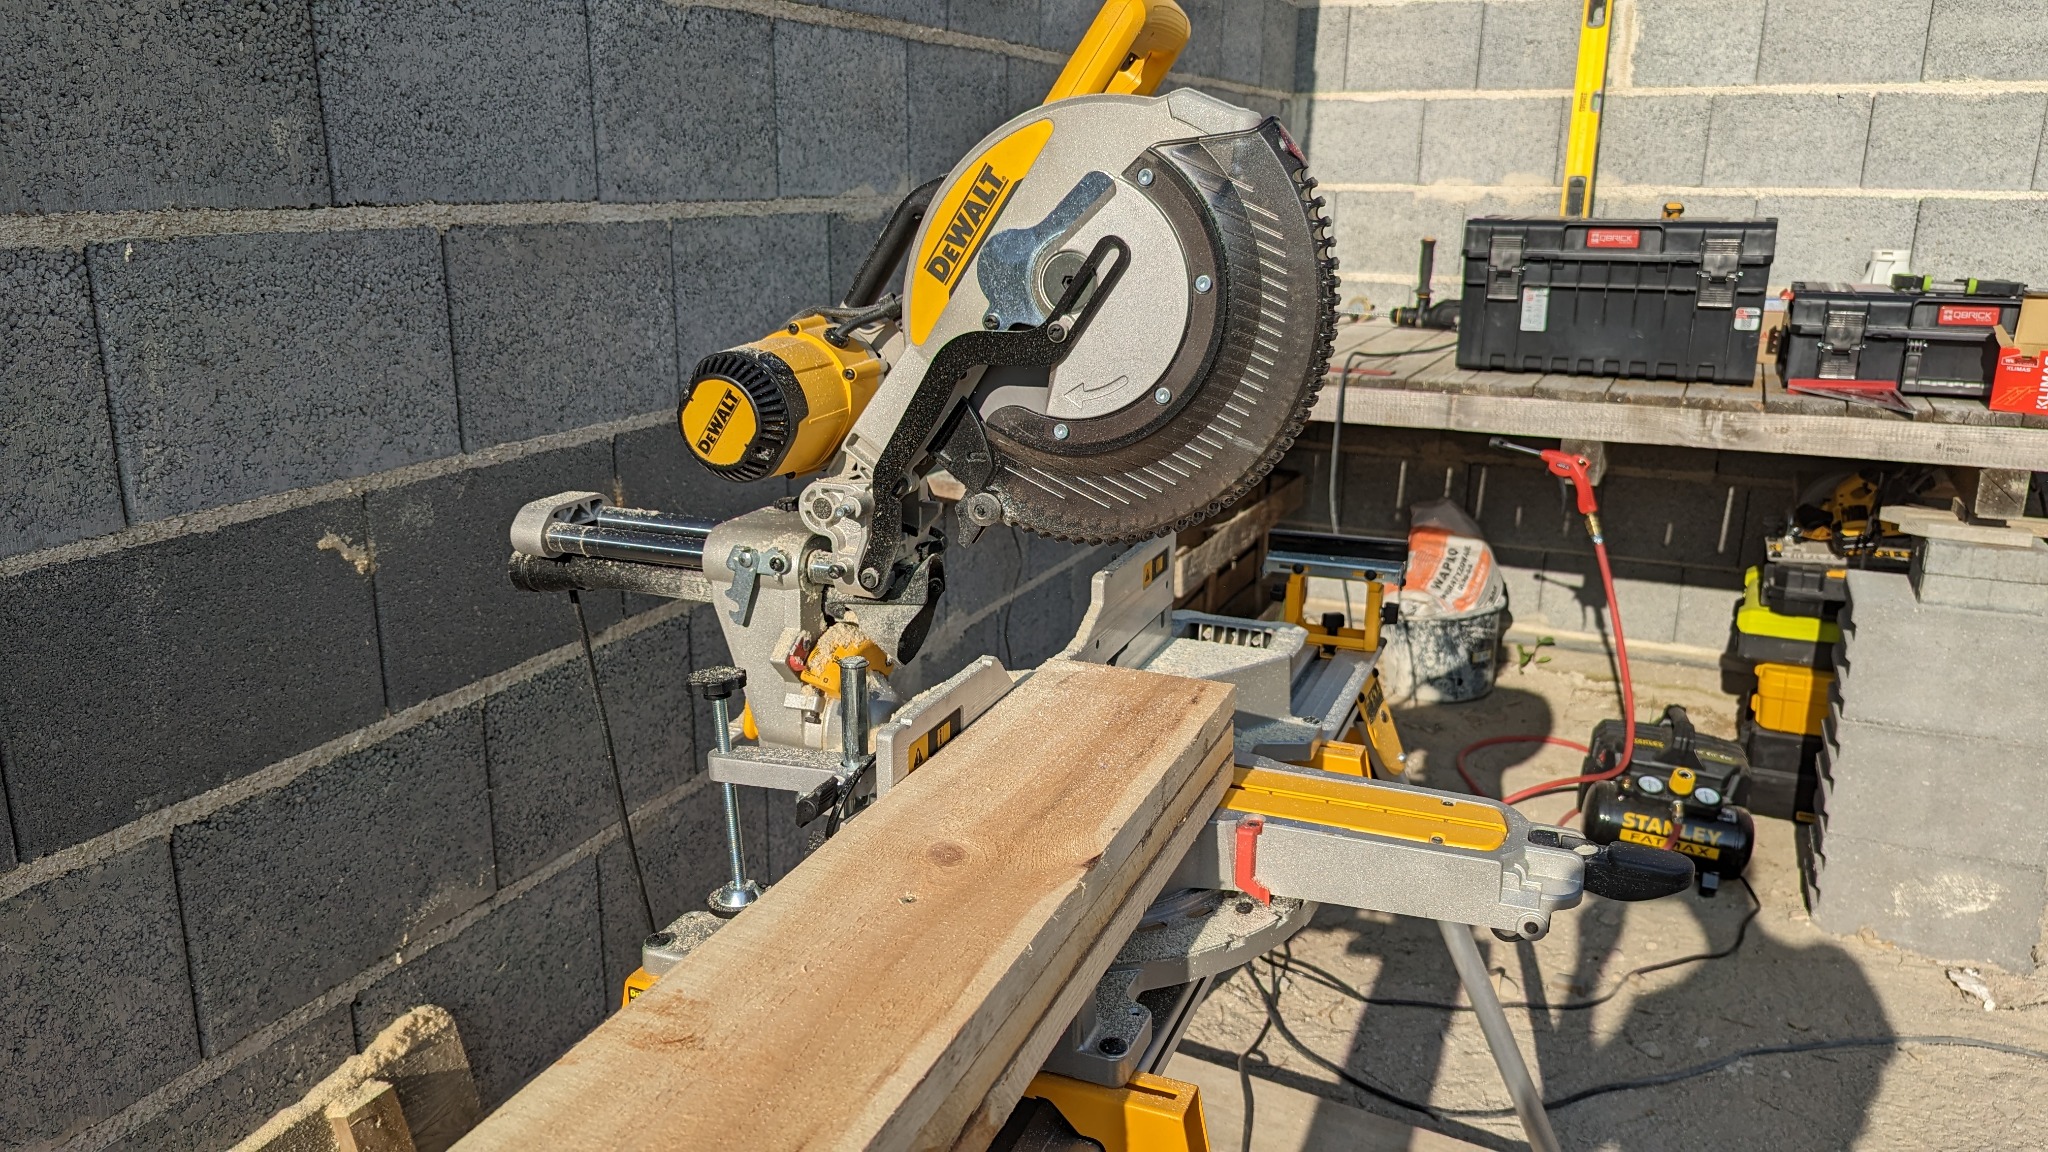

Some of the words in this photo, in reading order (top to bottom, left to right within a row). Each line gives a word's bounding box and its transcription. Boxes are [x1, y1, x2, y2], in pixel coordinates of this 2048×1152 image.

[926, 164, 1004, 284] DEWALT
[1953, 311, 1993, 320] QBRICK
[2036, 356, 2048, 410] KLIM
[697, 389, 739, 454] DEWALT
[1622, 811, 1723, 846] STANLEY
